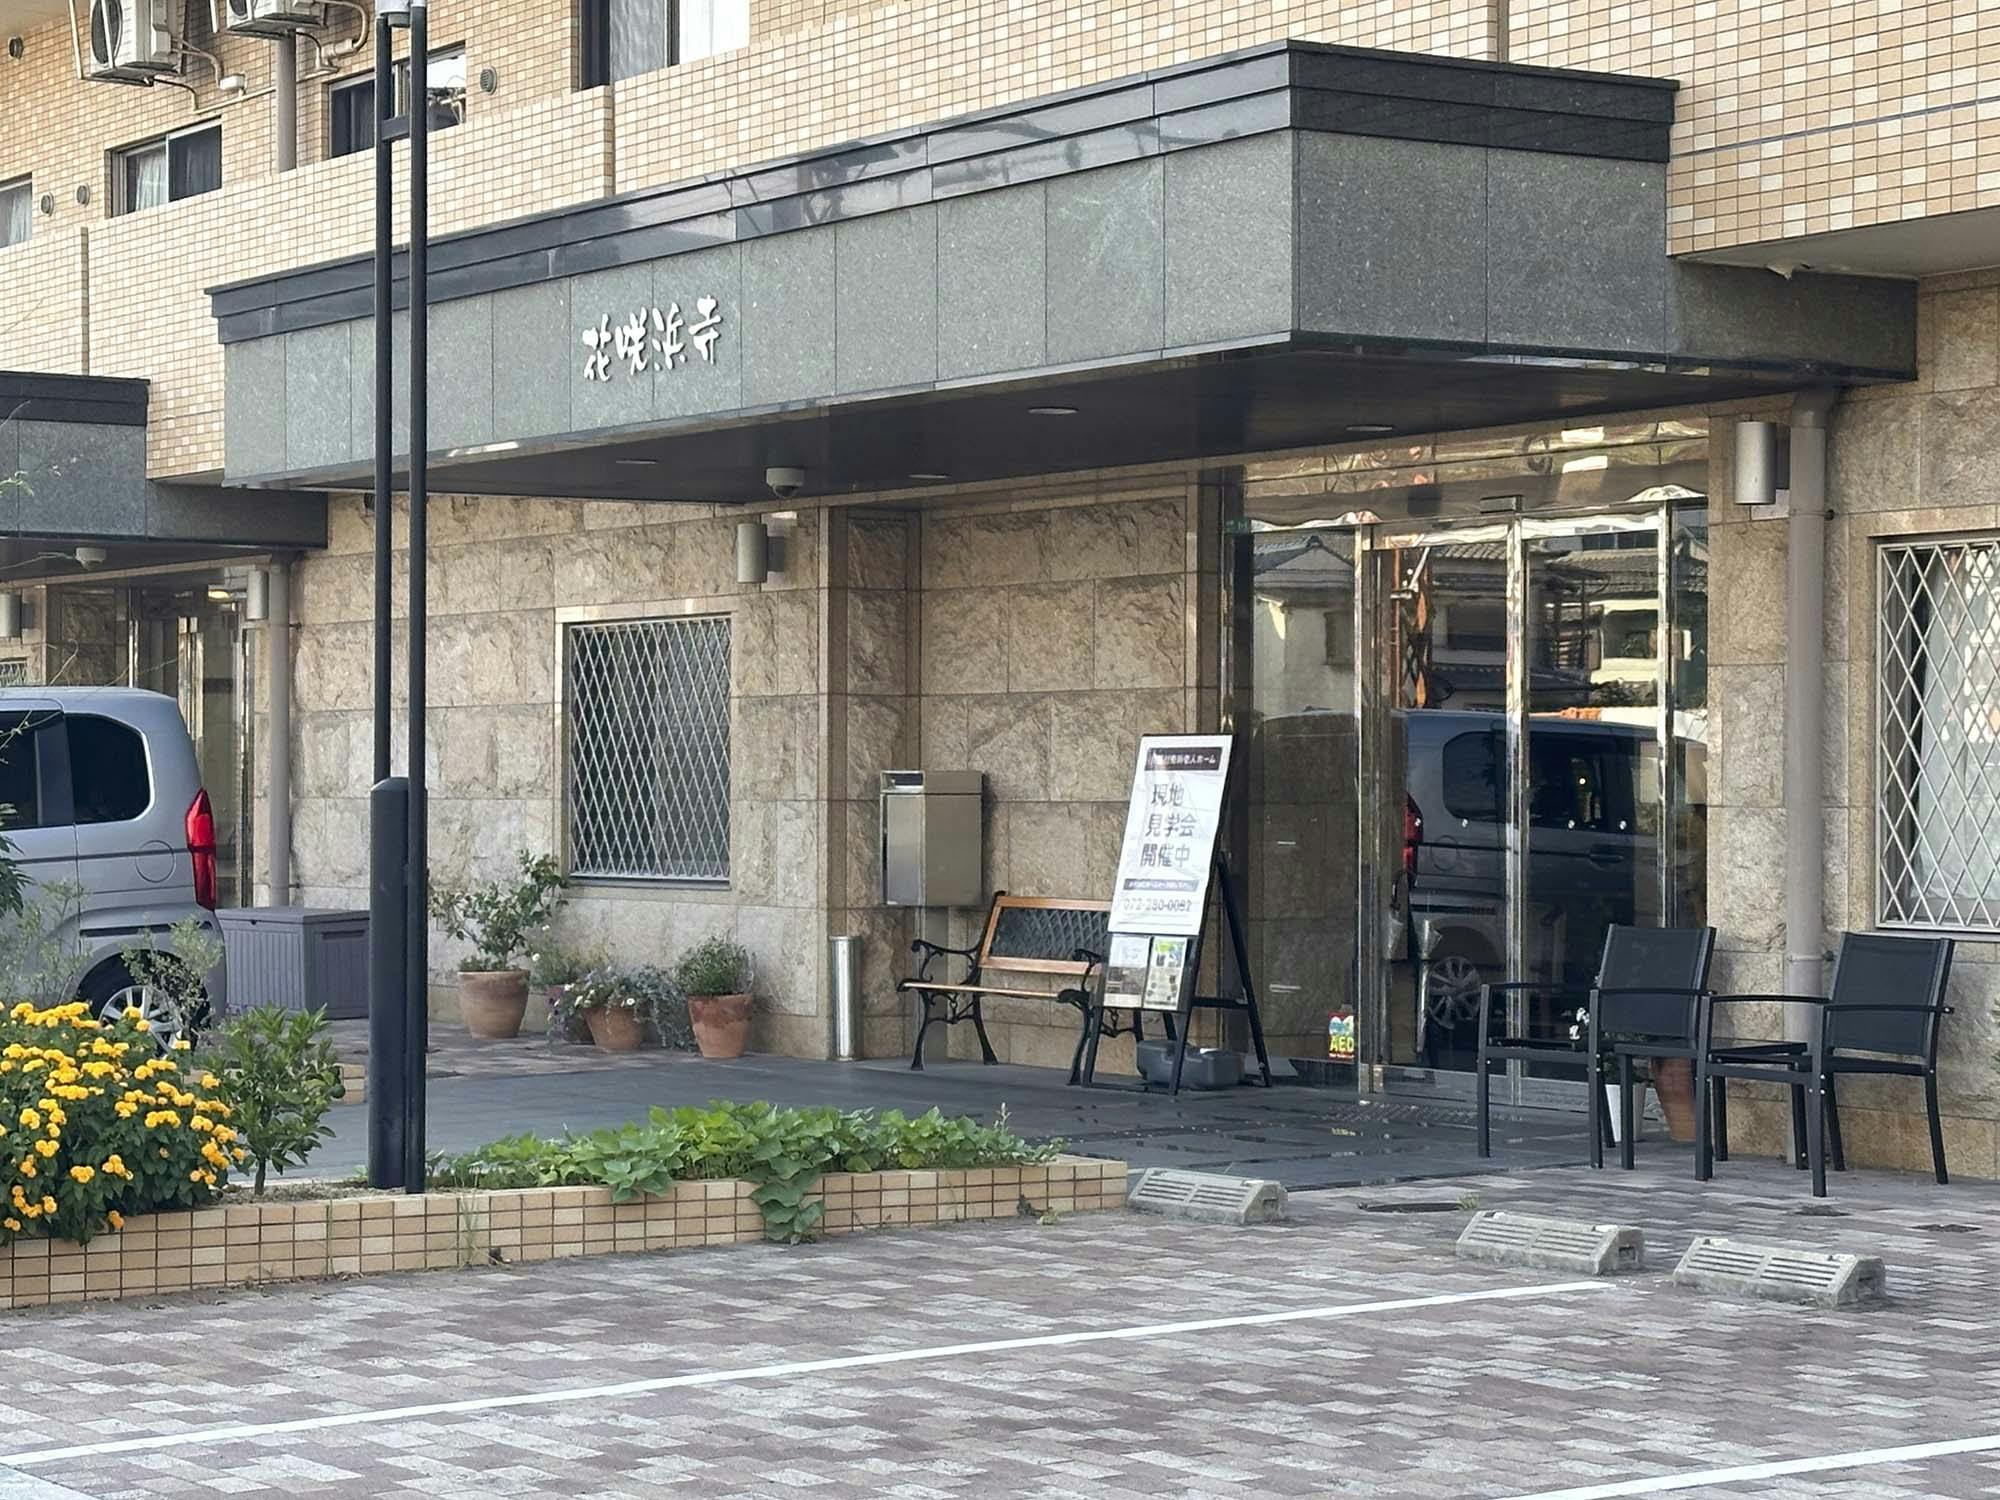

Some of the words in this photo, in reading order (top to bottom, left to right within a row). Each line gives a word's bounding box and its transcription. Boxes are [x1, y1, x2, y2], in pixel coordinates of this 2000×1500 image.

[582, 294, 722, 381] 花咲浜寺
[1151, 783, 1185, 807] 現地
[1145, 813, 1197, 837] 見学会
[1141, 843, 1190, 867] 開催中
[1329, 1036, 1354, 1052] AED
